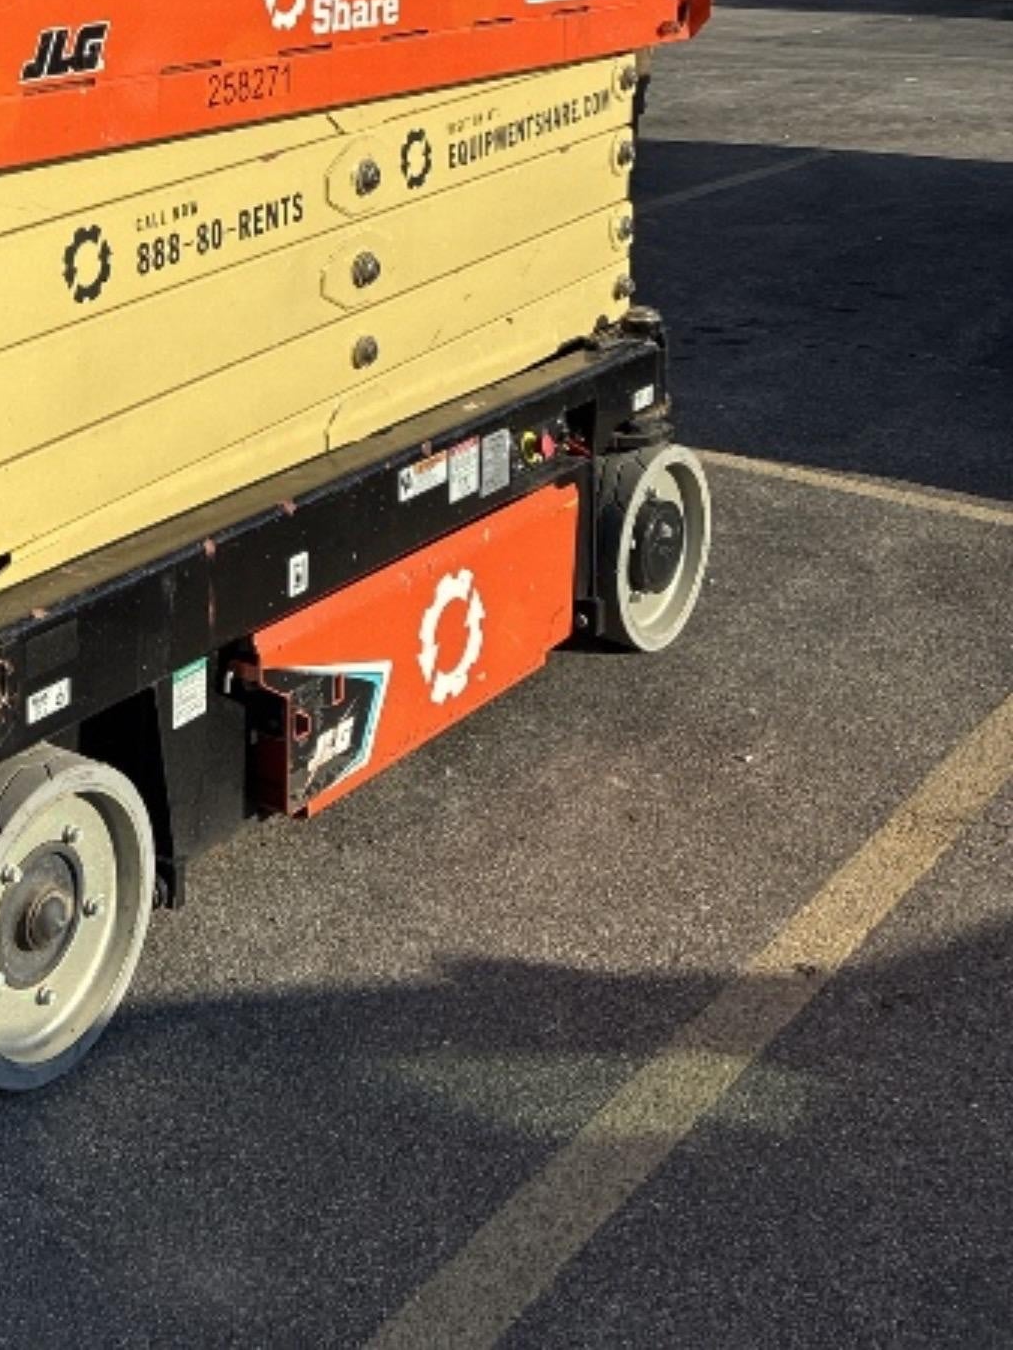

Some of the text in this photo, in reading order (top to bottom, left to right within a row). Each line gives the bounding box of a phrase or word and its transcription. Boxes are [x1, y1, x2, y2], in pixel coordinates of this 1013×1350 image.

[19, 21, 111, 84] JLG
[206, 63, 292, 110] 258271
[448, 88, 611, 169] EQUIPMENTSHARE.COM
[136, 200, 198, 233] CALL NOW
[136, 191, 304, 276] 888-80-RENTS
